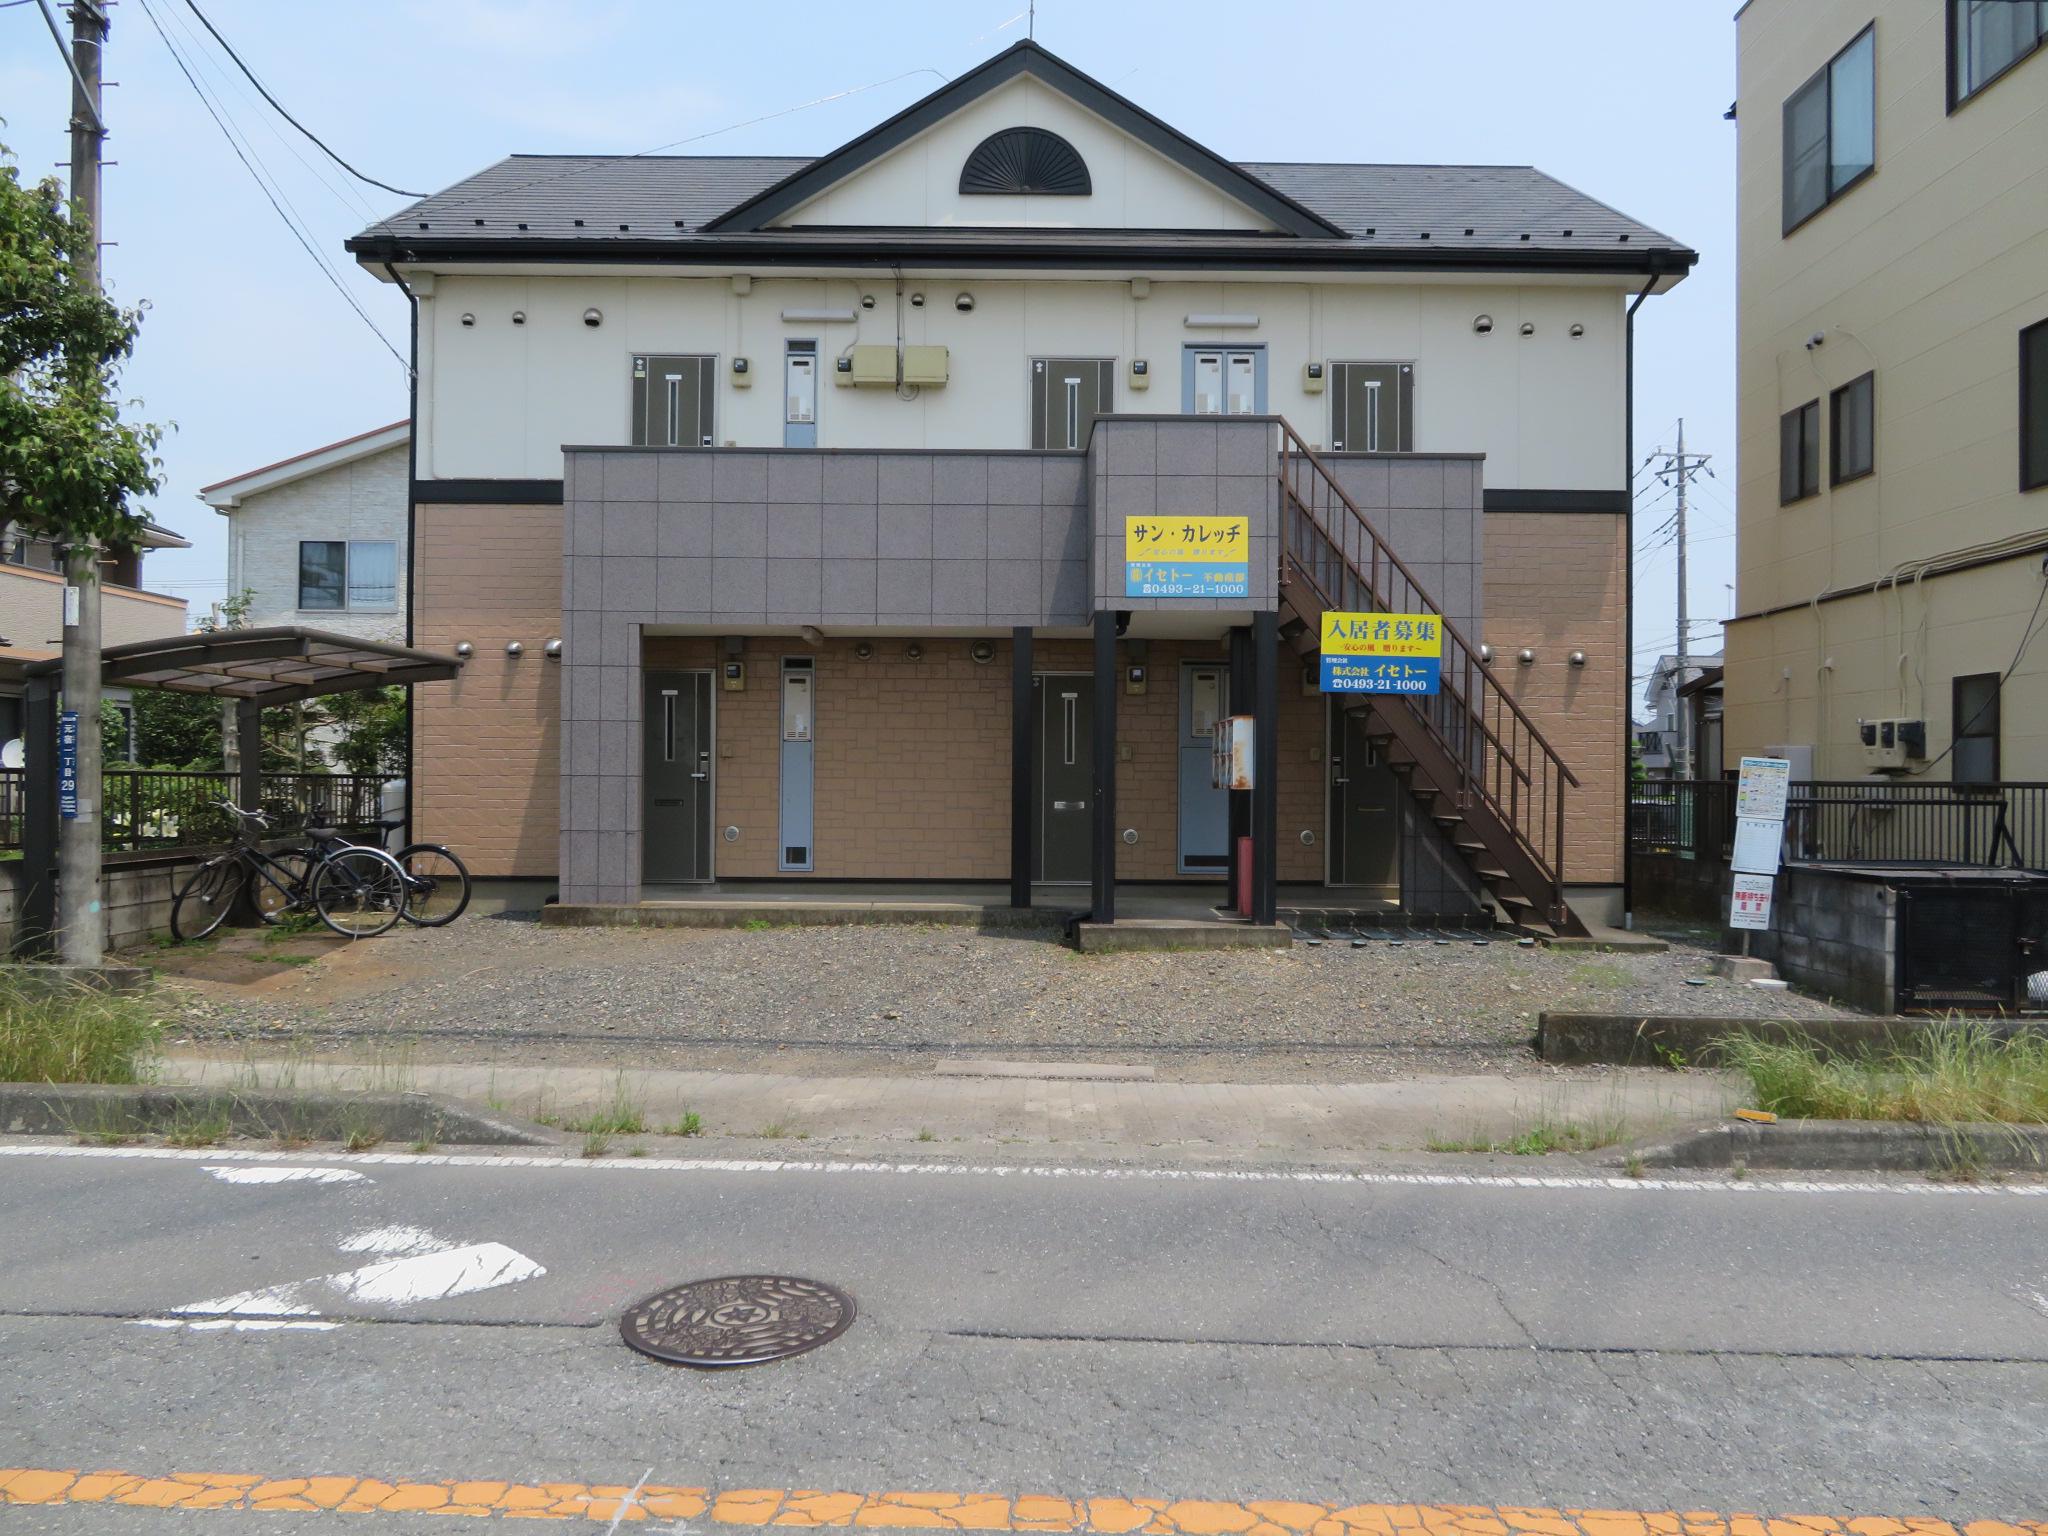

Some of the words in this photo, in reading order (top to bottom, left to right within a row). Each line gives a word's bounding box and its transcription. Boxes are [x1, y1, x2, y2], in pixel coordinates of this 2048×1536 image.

[1134, 524, 1241, 543] サン・カレッチ
[1328, 619, 1435, 641] 入居者募集
[1332, 666, 1370, 677] 株式会社
[1374, 664, 1428, 678] イセトー
[1343, 678, 1427, 691] 0493-21-1000
[61, 780, 75, 791] 29
